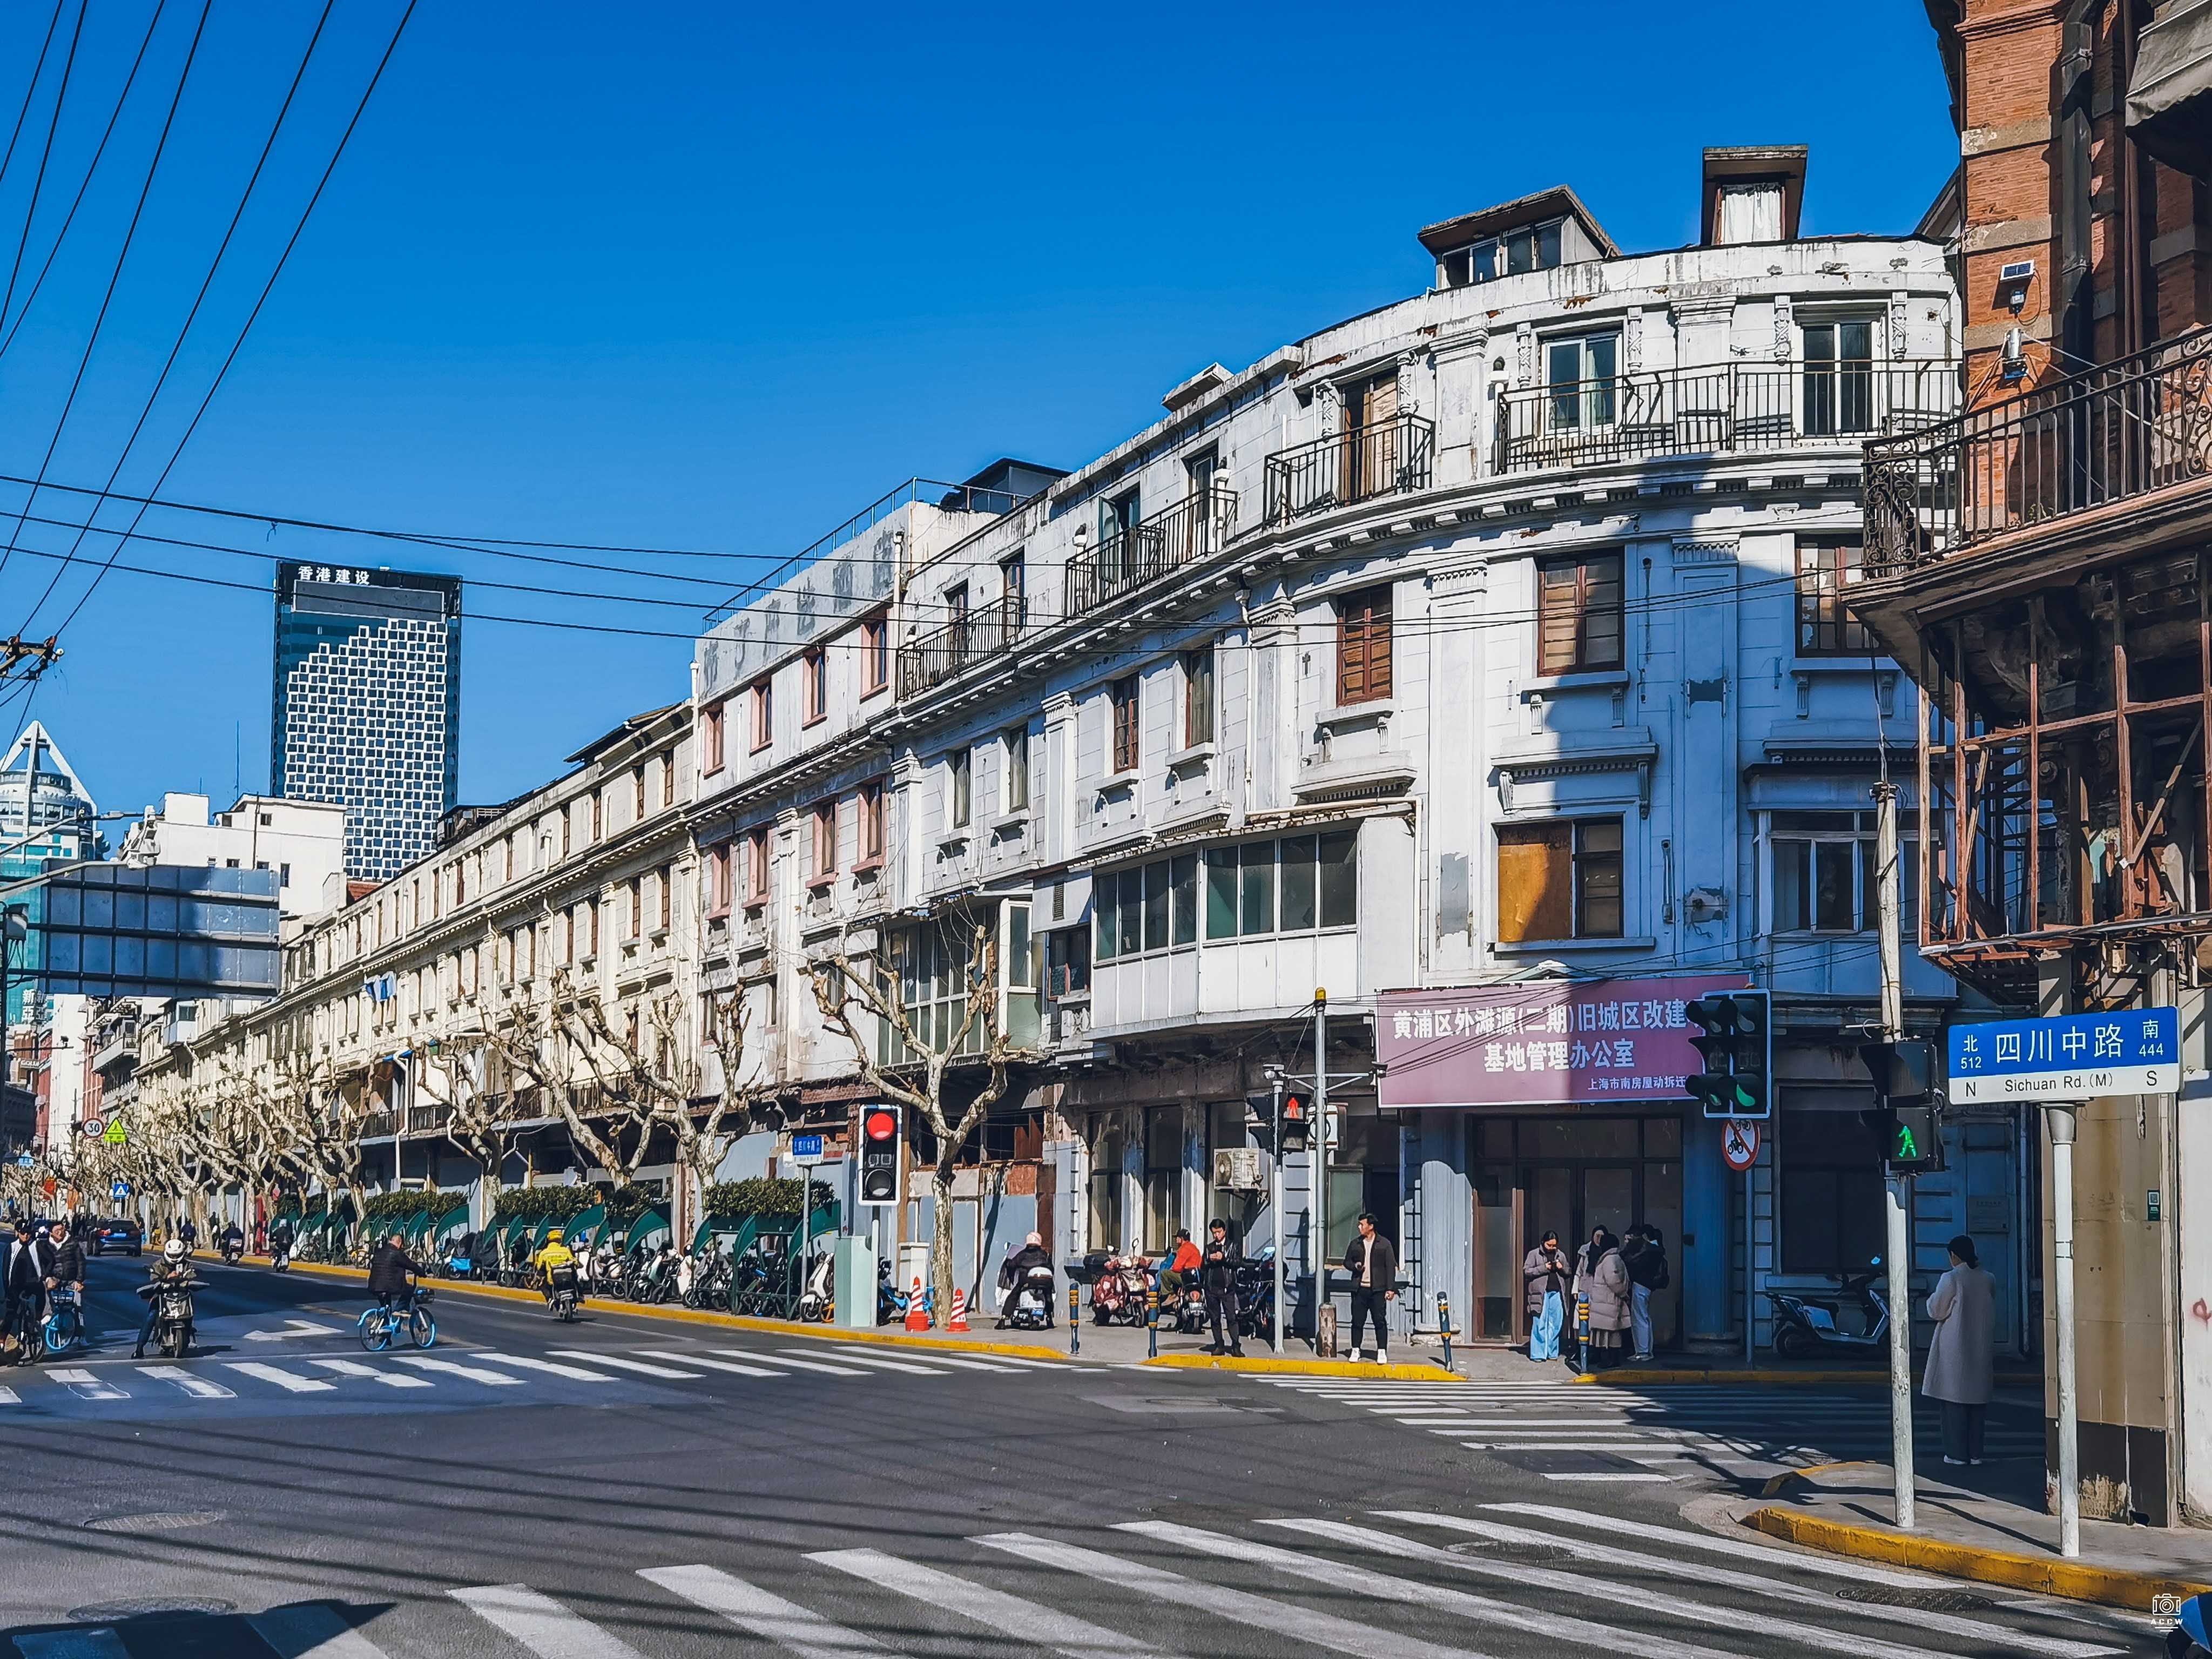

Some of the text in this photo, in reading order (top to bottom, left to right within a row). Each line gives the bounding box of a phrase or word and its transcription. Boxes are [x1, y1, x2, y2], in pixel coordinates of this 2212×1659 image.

[298, 565, 370, 584] 香港建设
[1392, 999, 1699, 1039] 黄浦区外滩源(二期)旧城区改建
[2142, 1020, 2159, 1040] 南
[1964, 1035, 1978, 1053] 北
[1996, 1023, 2123, 1063] 四川中路
[2139, 1043, 2164, 1057] 444
[1484, 1038, 1635, 1072] 基地管理办公室
[1961, 1057, 1981, 1069] 512
[2005, 1077, 2056, 1092] Sichuan
[2146, 1070, 2157, 1087] S
[1966, 1082, 1977, 1097] N
[88, 1123, 100, 1133] 30
